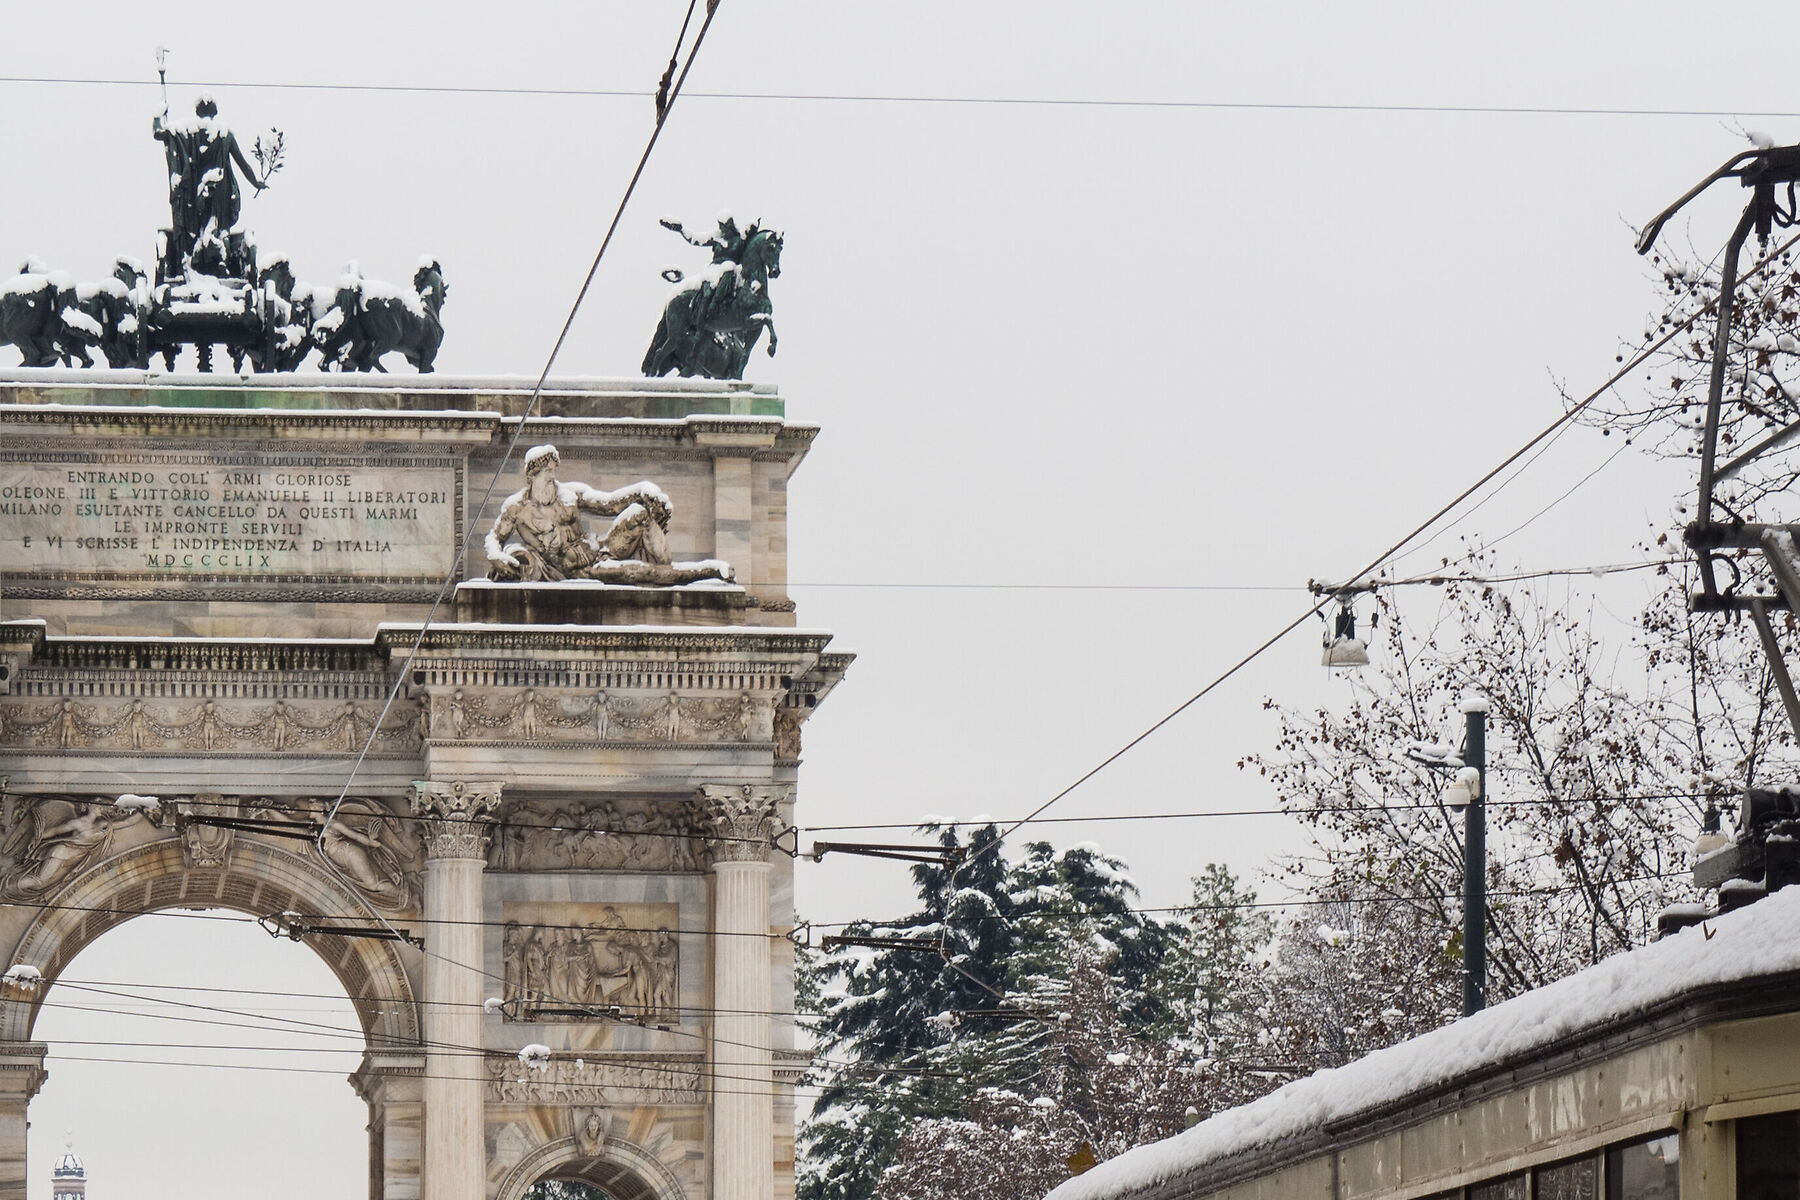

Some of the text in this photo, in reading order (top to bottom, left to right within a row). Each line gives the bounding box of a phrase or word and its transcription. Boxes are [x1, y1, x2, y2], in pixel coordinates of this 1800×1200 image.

[67, 471, 154, 484] ENTRANDO
[223, 473, 261, 485] ARMI
[275, 474, 351, 487] GLORIOSE
[80, 488, 95, 500] III
[110, 488, 118, 500] E
[132, 488, 210, 501] VITTORIO
[223, 490, 311, 502] EMANUELE
[324, 491, 334, 502] II
[348, 491, 446, 504] LIBERATORI
[0, 502, 62, 516] MILANO
[76, 503, 163, 517] ESULTANTE
[267, 507, 287, 519] DA
[299, 507, 355, 520] QUESTI
[366, 508, 418, 520] MARMI
[114, 521, 302, 535] LE IMPRONTE SERVILI
[23, 536, 31, 548] E
[46, 536, 63, 549] VI
[76, 537, 138, 550] SCRISSE
[173, 538, 299, 552] INDIPENDENZA
[337, 540, 392, 553] ITALIA
